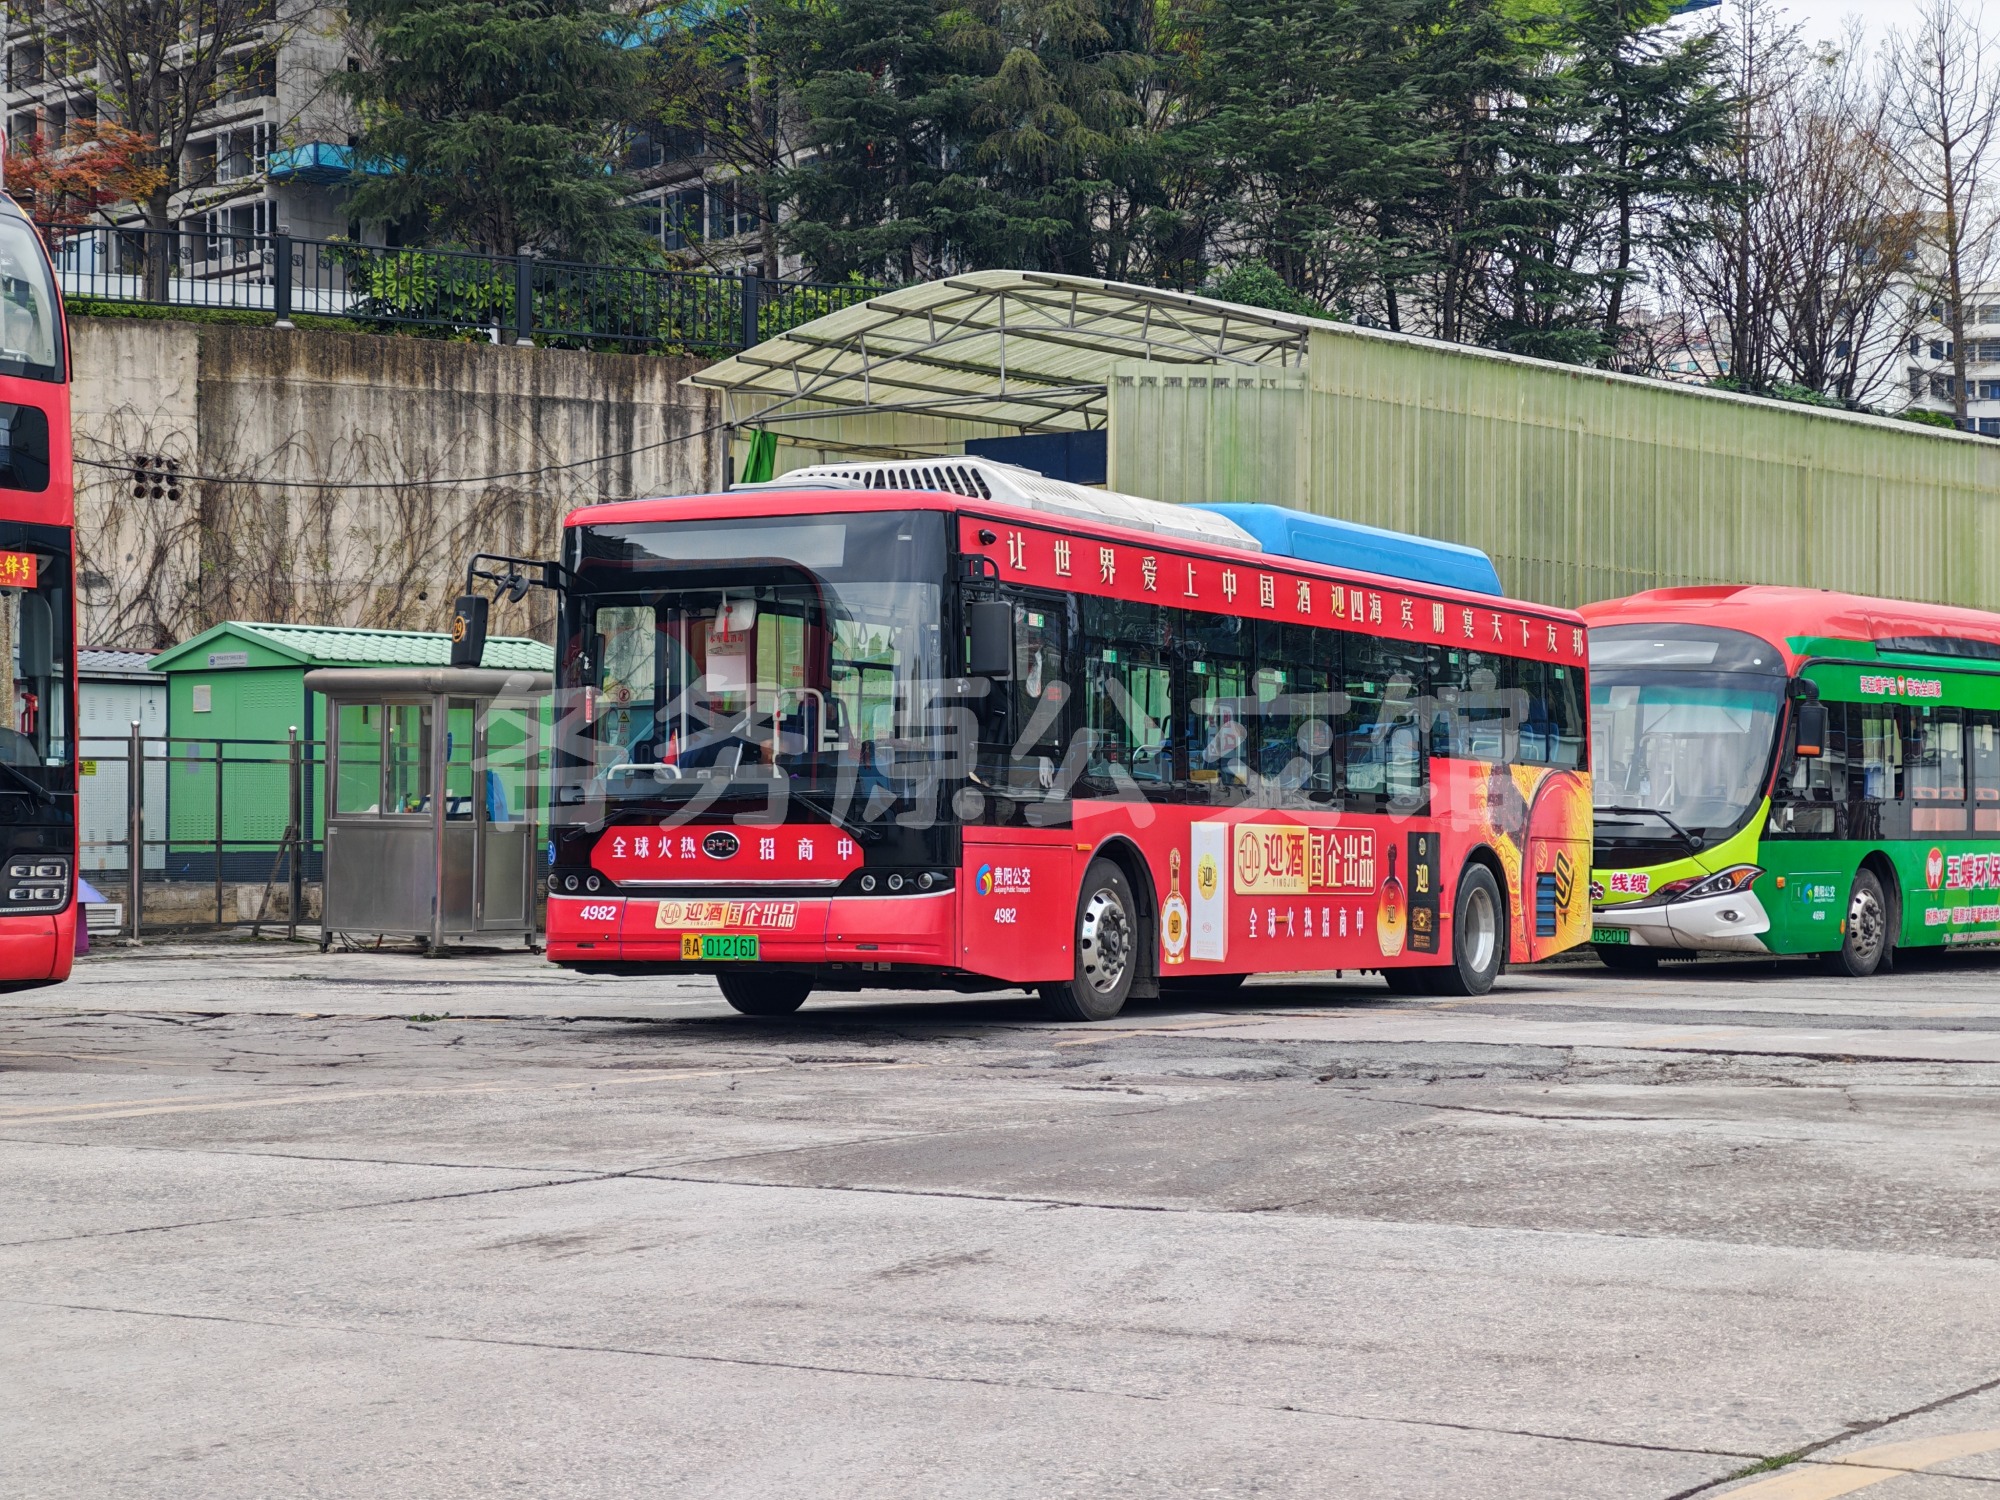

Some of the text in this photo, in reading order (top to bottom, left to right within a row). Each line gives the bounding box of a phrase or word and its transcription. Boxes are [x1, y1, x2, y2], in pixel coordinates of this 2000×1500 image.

[612, 836, 696, 859] 全球火热
[706, 839, 736, 851] BYD
[759, 837, 853, 860] 招商中
[1264, 833, 1374, 887] 迎酒 国企出品
[994, 867, 1031, 885] 贵阳公交
[1611, 872, 1650, 894] 线缆
[580, 905, 617, 921] 4982
[683, 902, 795, 928] 迎酒 国企出品
[994, 907, 1017, 923] 4982
[1249, 906, 1364, 938] 全球火热招商中
[1593, 929, 1629, 943] 03201D
